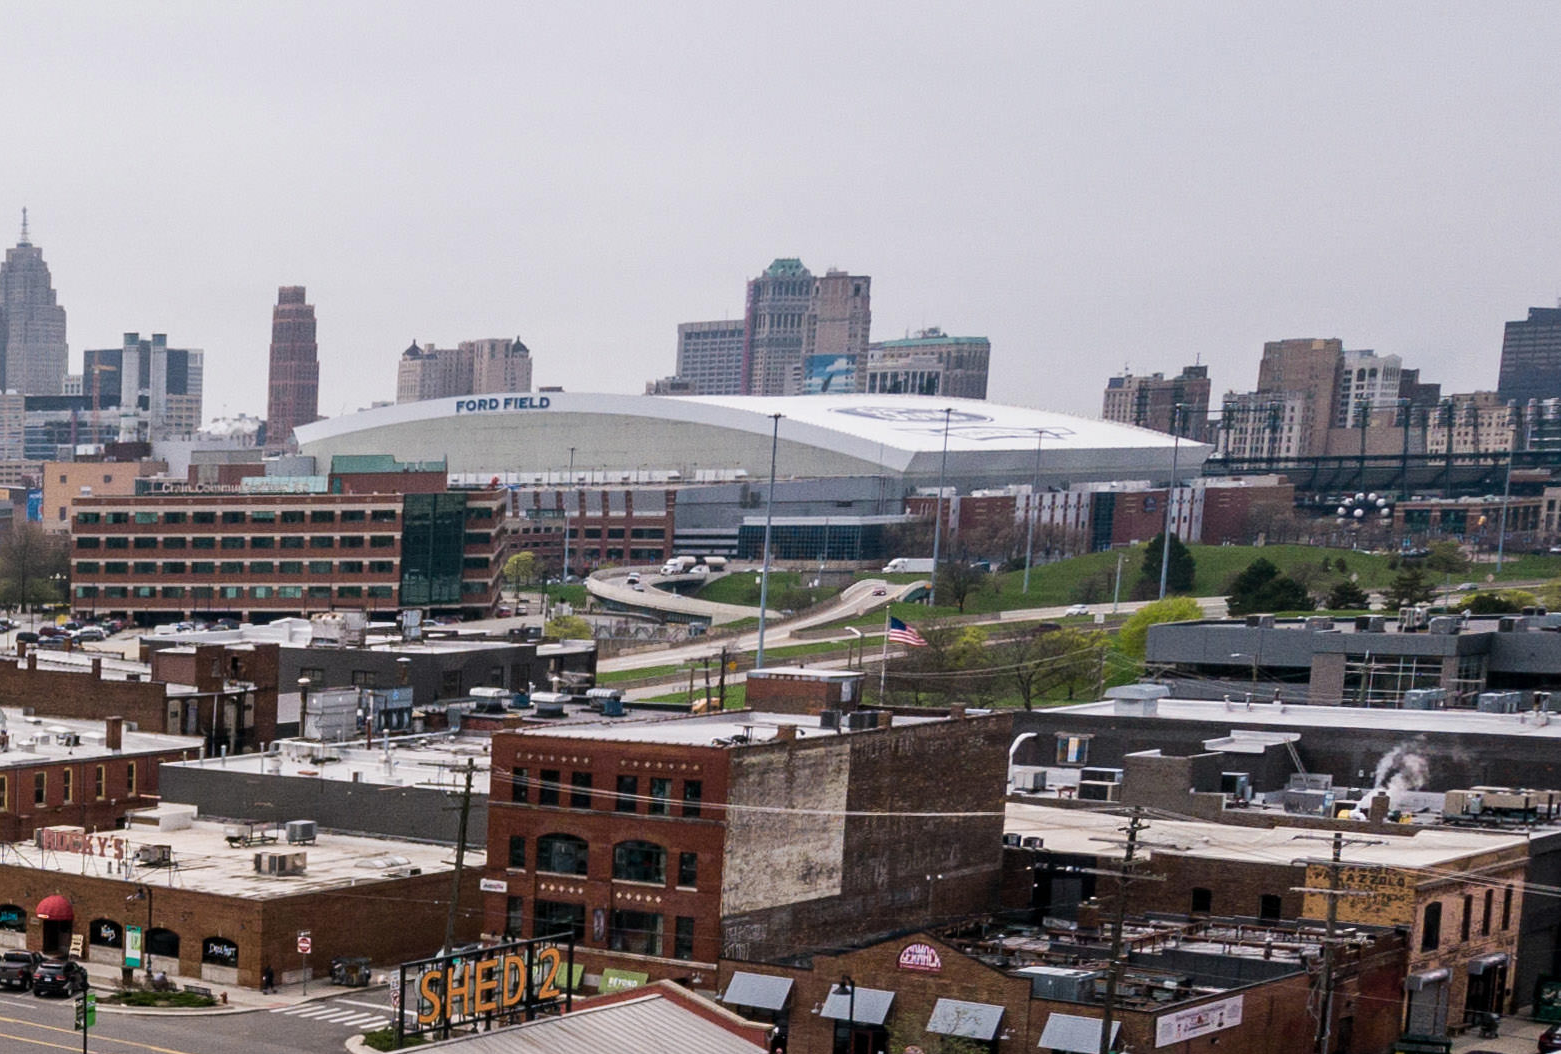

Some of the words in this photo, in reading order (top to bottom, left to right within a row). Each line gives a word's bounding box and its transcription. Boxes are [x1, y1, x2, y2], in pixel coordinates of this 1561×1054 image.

[456, 398, 499, 412] FORD
[503, 396, 550, 410] FIELD
[43, 828, 125, 860] ROCKY'S
[418, 955, 527, 1024] SHED
[538, 947, 560, 1000] 2
